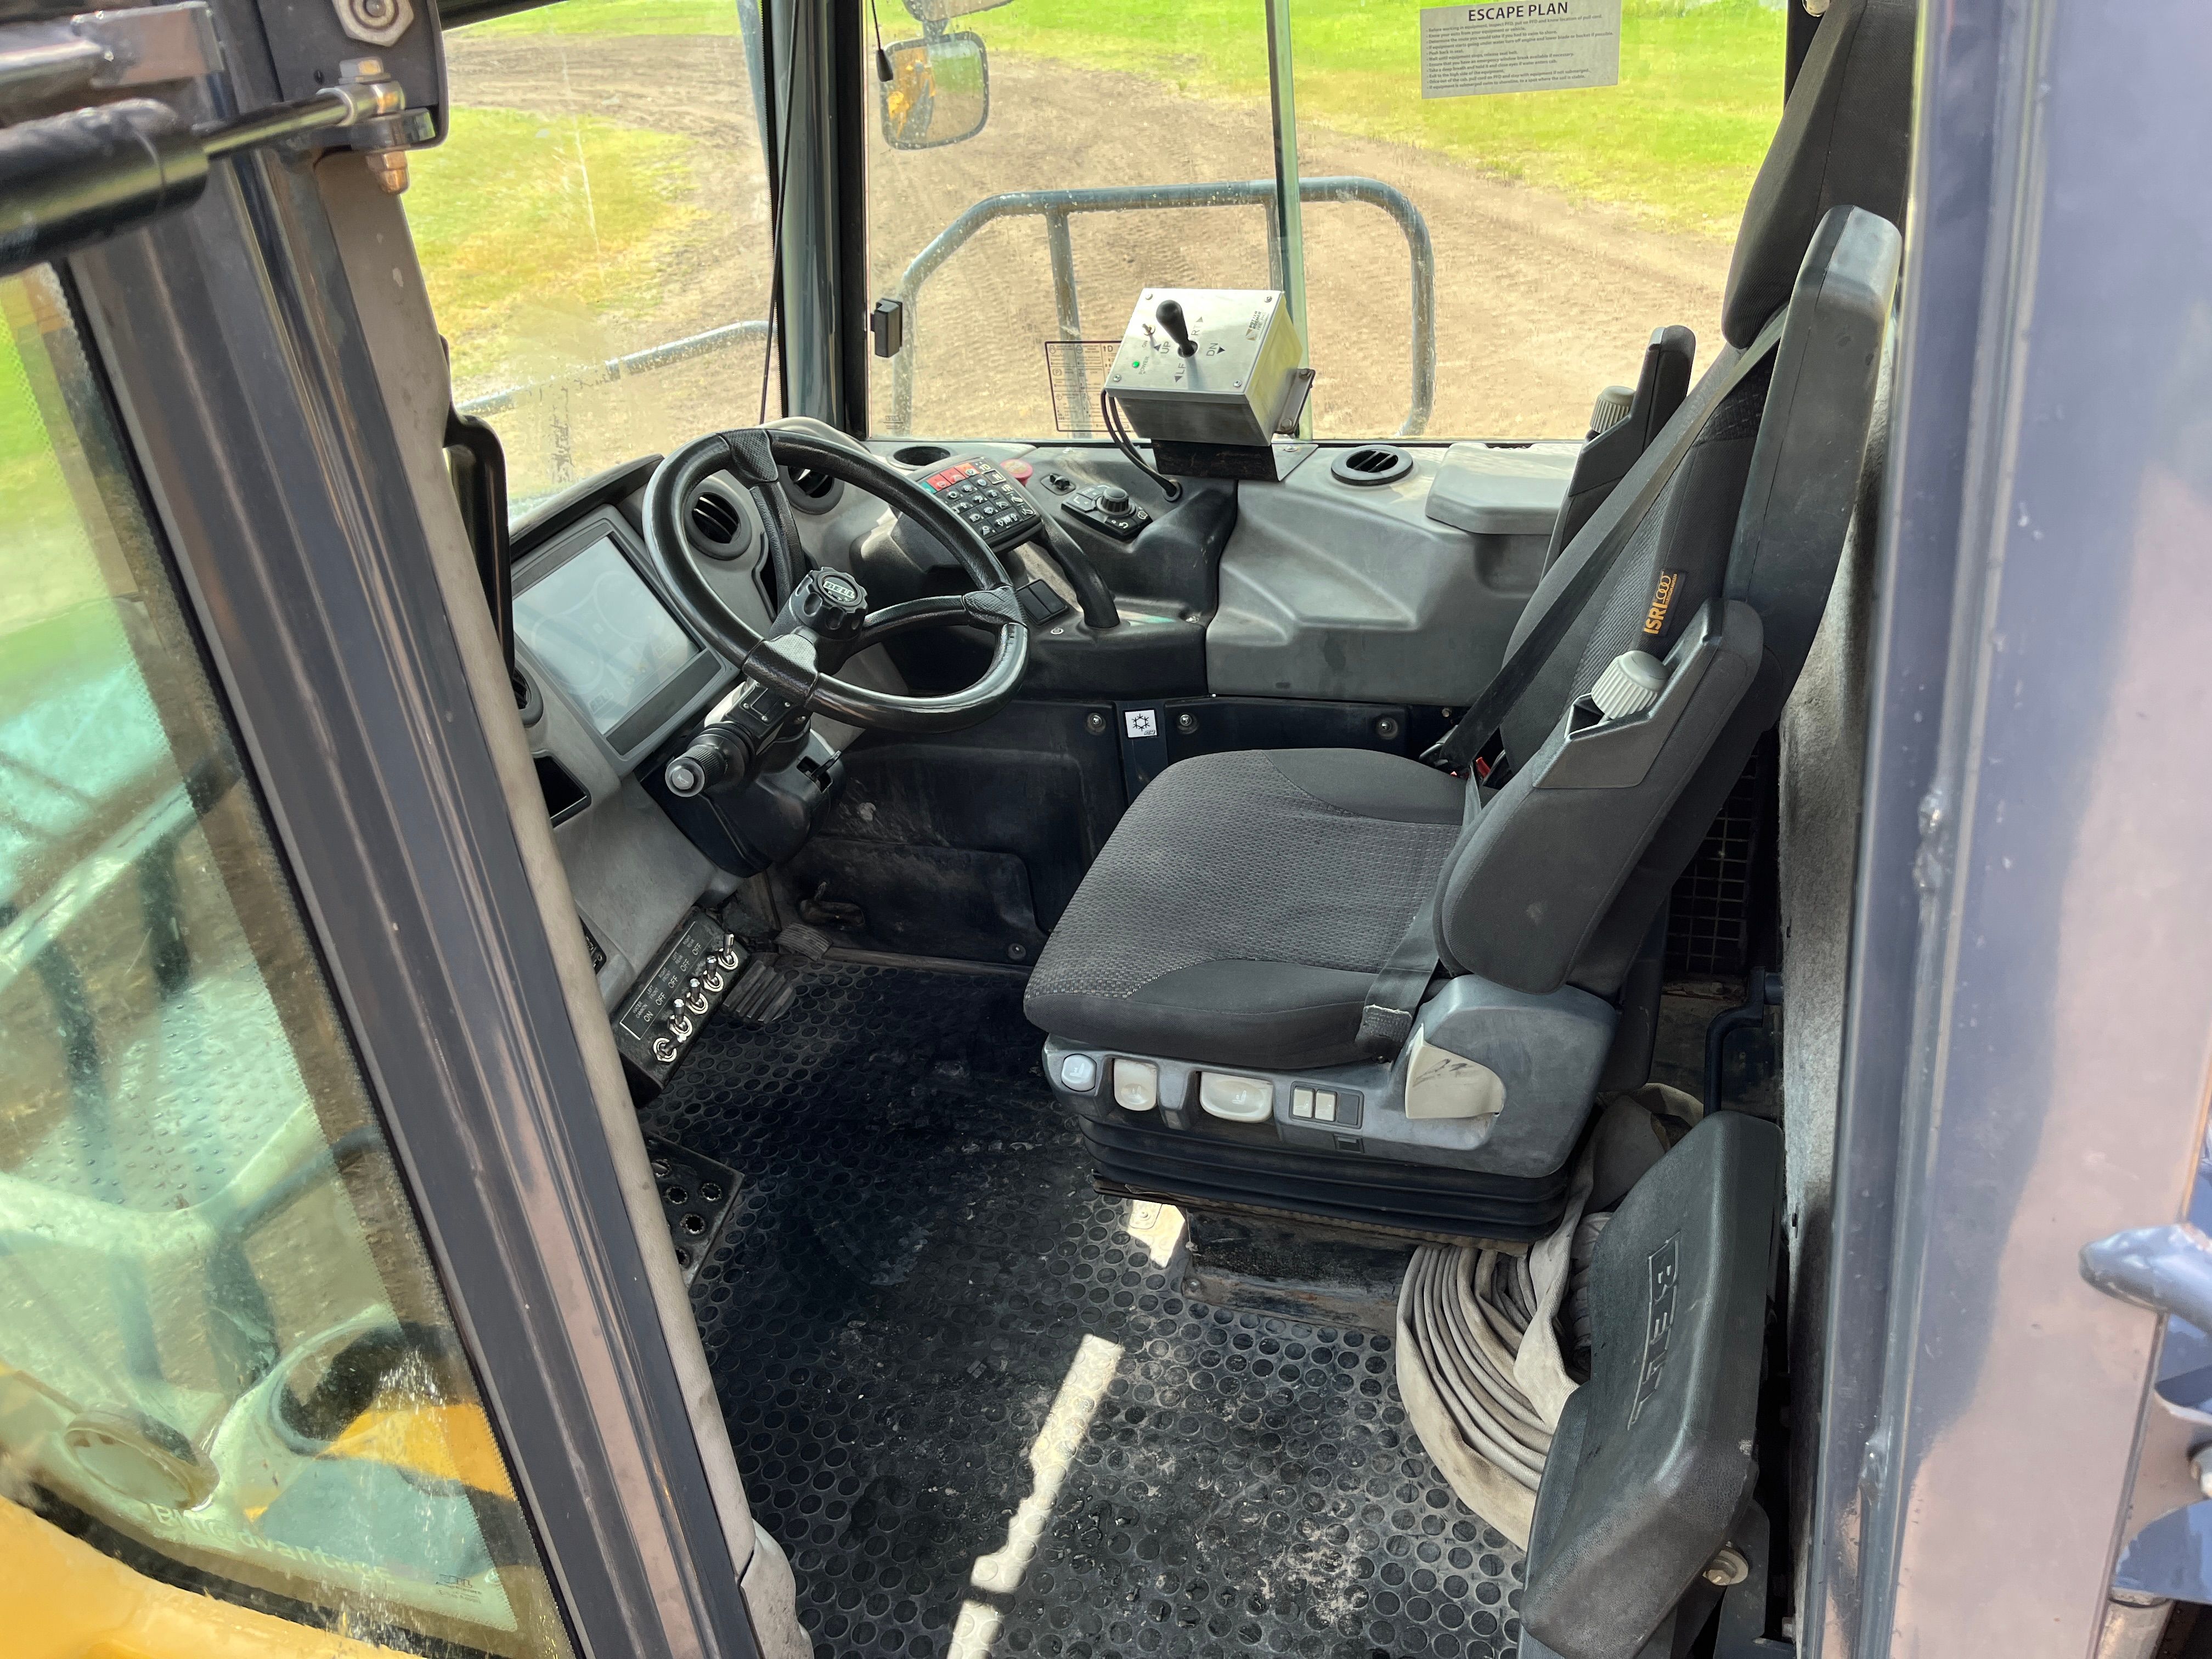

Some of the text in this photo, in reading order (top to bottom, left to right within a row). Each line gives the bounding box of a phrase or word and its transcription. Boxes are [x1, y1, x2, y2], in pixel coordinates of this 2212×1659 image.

[1469, 1, 1568, 21] ESCAPE PLAN
[1191, 324, 1200, 336] RT
[1160, 341, 1172, 354] UP
[1206, 343, 1218, 356] DN
[1138, 357, 1149, 375] POWER
[1177, 363, 1186, 374] LF
[823, 580, 855, 599] BELL
[1644, 602, 1668, 634] ISRI
[692, 943, 702, 955] OFF
[680, 958, 690, 972] OFF
[668, 975, 678, 988] OFF
[650, 987, 659, 1000] FRONT
[655, 992, 666, 1006] OFF
[636, 1003, 648, 1018] CANNON
[644, 1011, 653, 1022] ON
[1627, 1232, 1680, 1431] BELL
